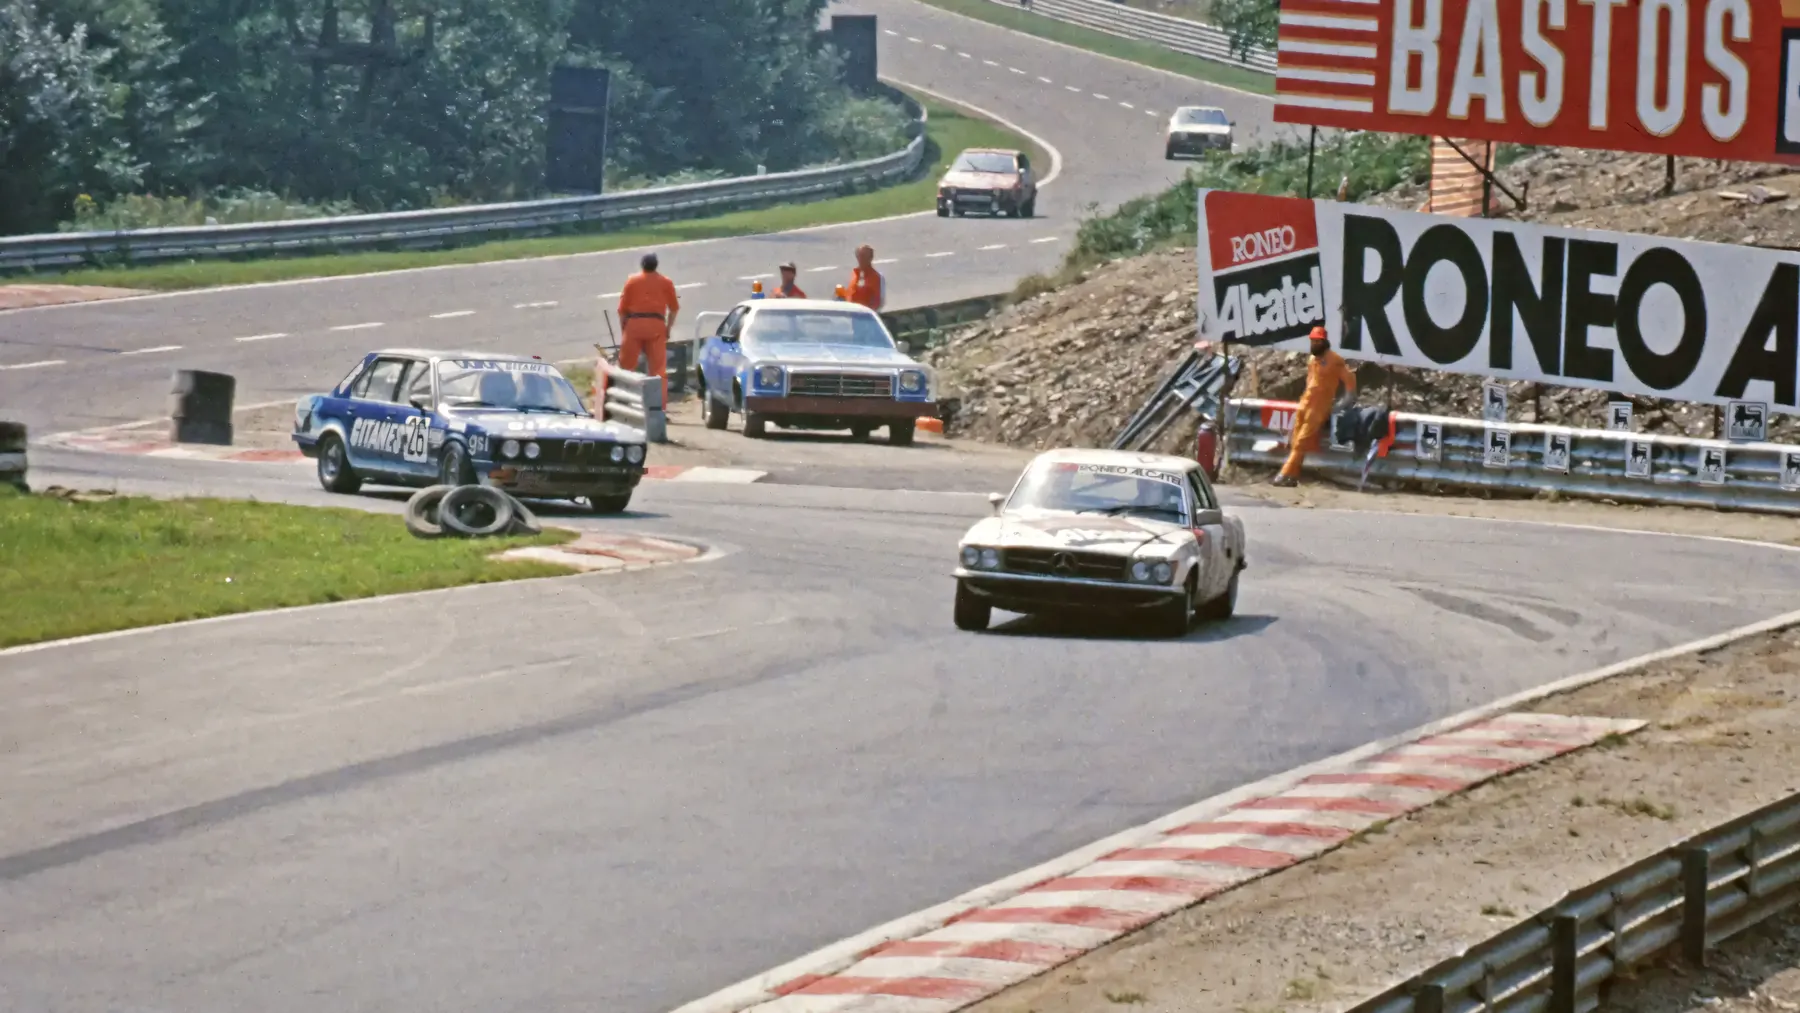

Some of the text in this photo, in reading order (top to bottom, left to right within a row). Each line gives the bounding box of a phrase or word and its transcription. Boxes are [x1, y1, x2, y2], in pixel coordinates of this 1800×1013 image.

[1387, 0, 1752, 143] BASTOS
[1230, 225, 1296, 263] RONEO
[1217, 265, 1324, 339] Alcatel
[1340, 213, 1708, 391] RONEO
[350, 416, 427, 457] GITANES 26
[1079, 464, 1128, 474] RONEO
